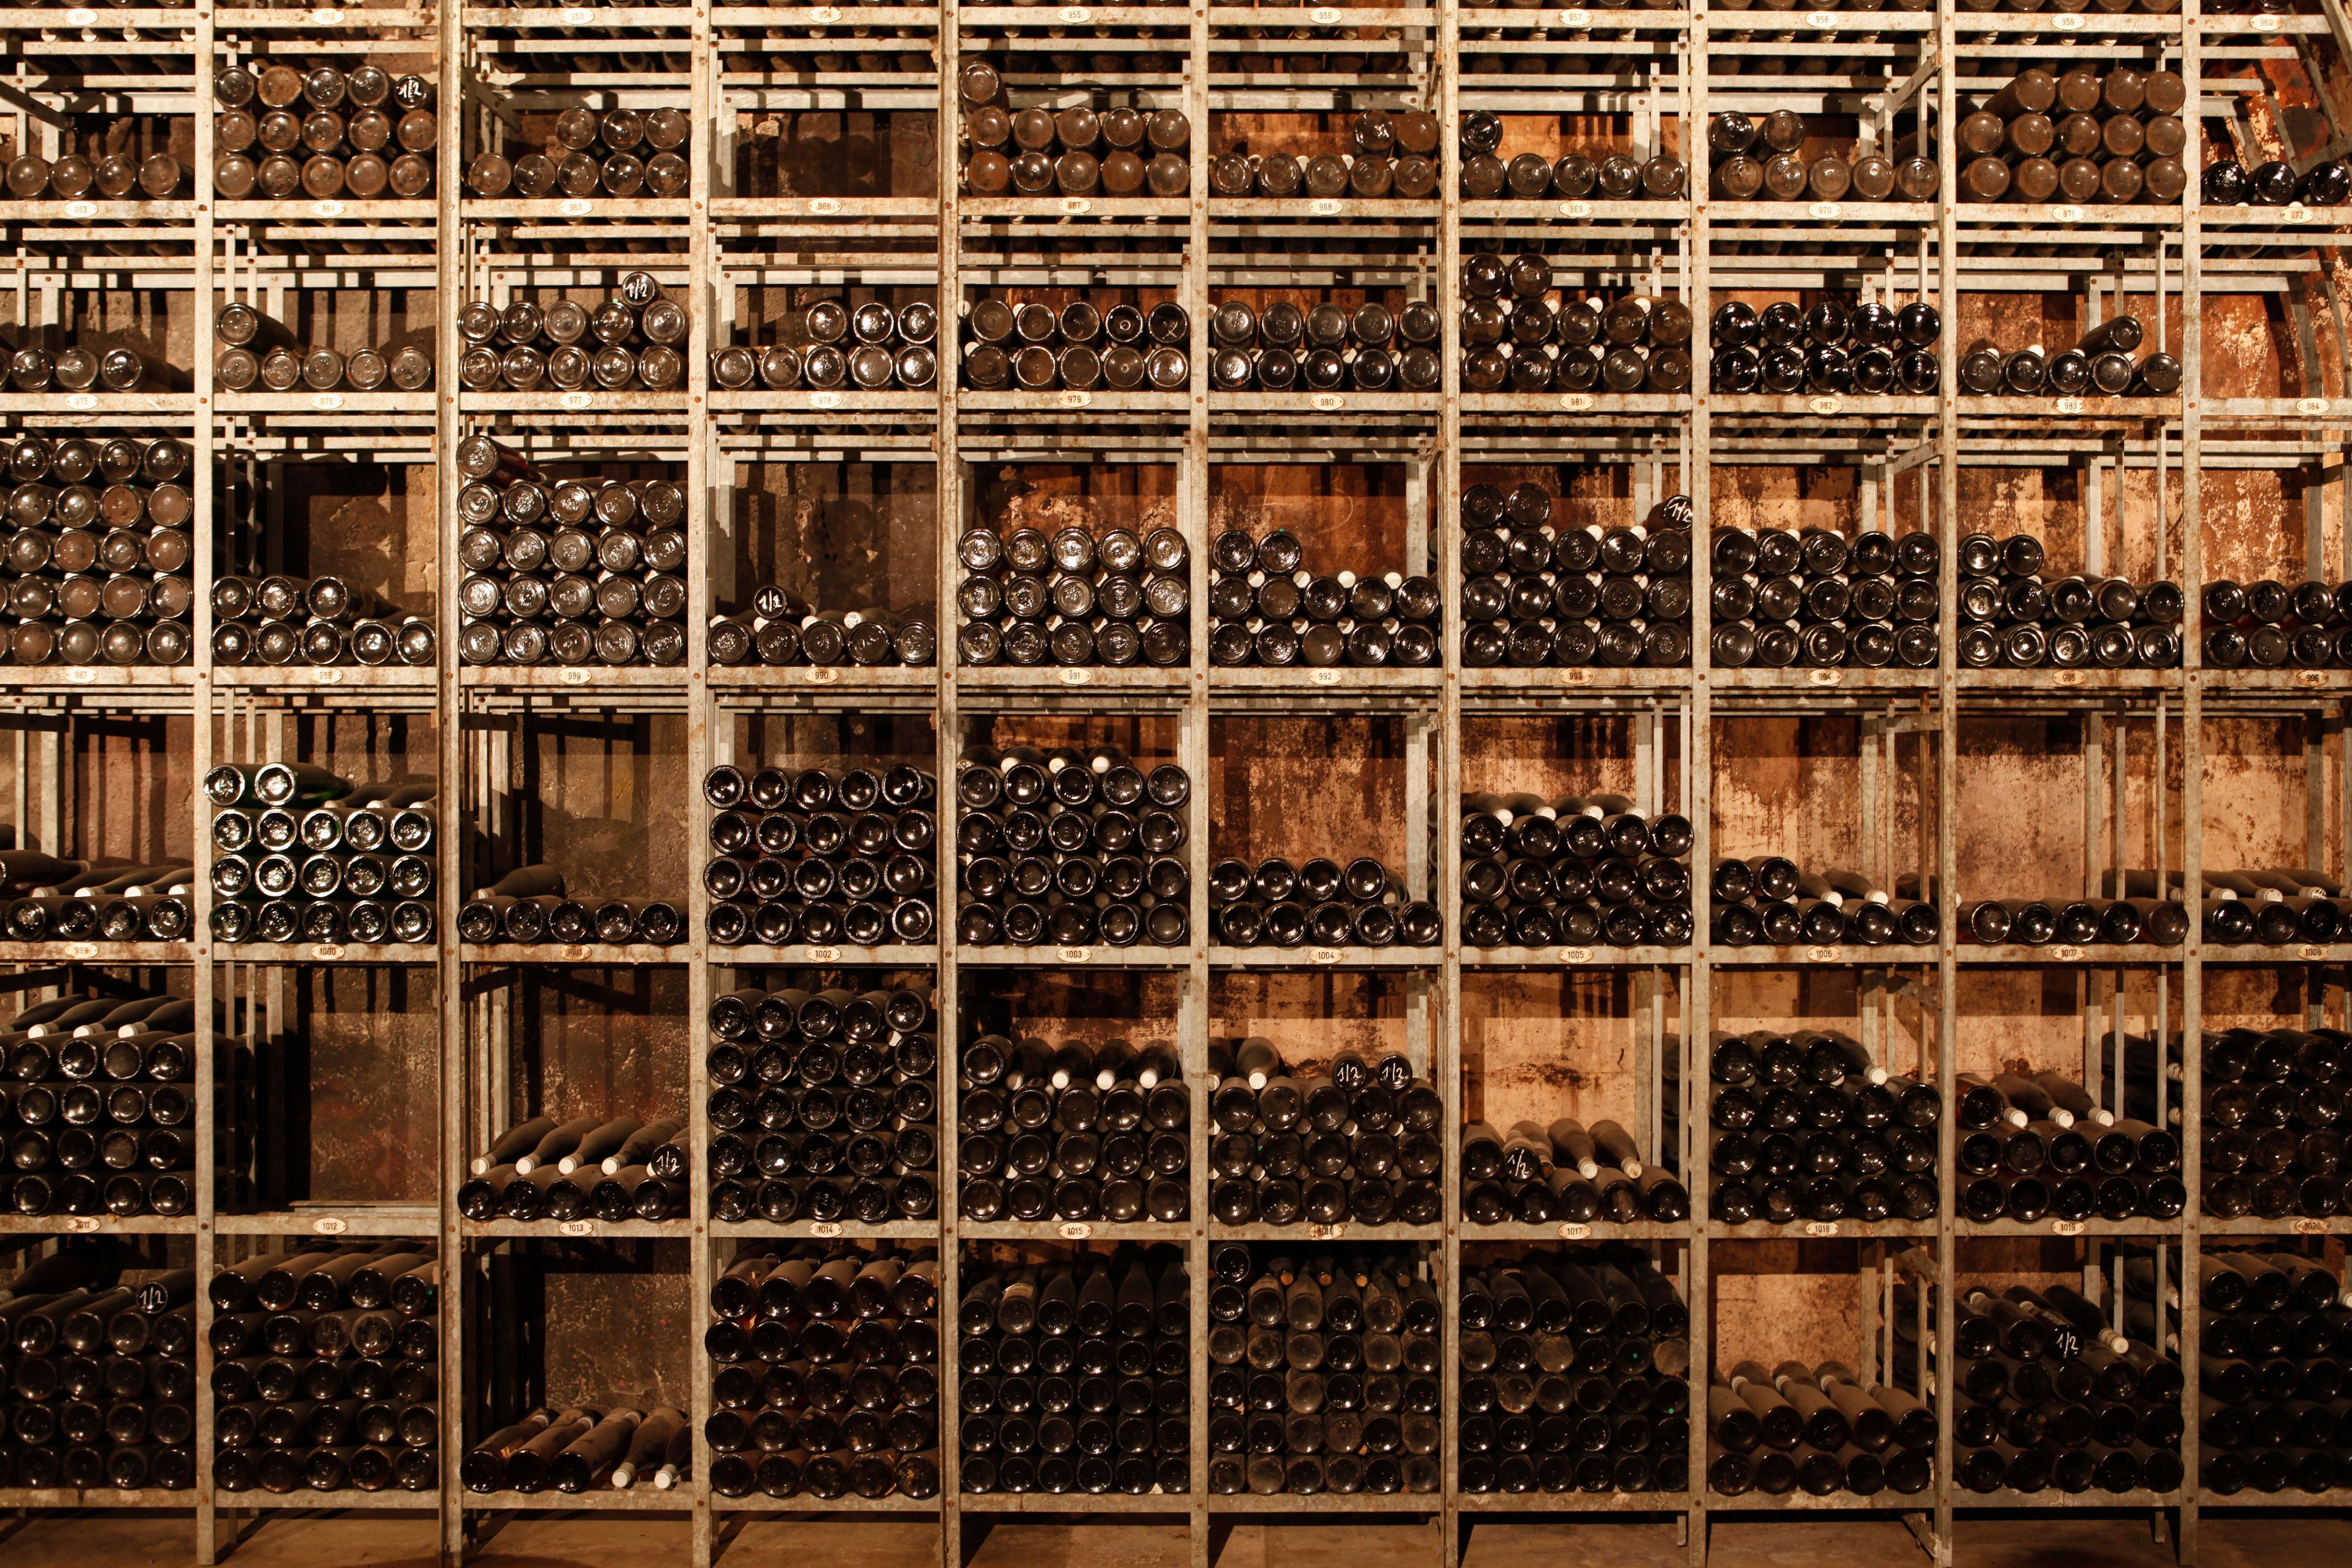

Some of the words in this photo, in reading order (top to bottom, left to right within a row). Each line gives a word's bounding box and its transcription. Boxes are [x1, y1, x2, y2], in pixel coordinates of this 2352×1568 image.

[399, 79, 422, 98] 1/2
[625, 279, 647, 299] 1/2
[1669, 501, 1693, 523] 1/2
[759, 590, 782, 612] 1/2
[1337, 1064, 1362, 1082] 1/2
[1382, 1063, 1404, 1081] 1/2
[657, 1151, 680, 1171] 1/2
[1508, 1150, 1529, 1176] 1/2
[139, 1287, 165, 1306] 1/2
[2056, 1332, 2079, 1351] 1/2
